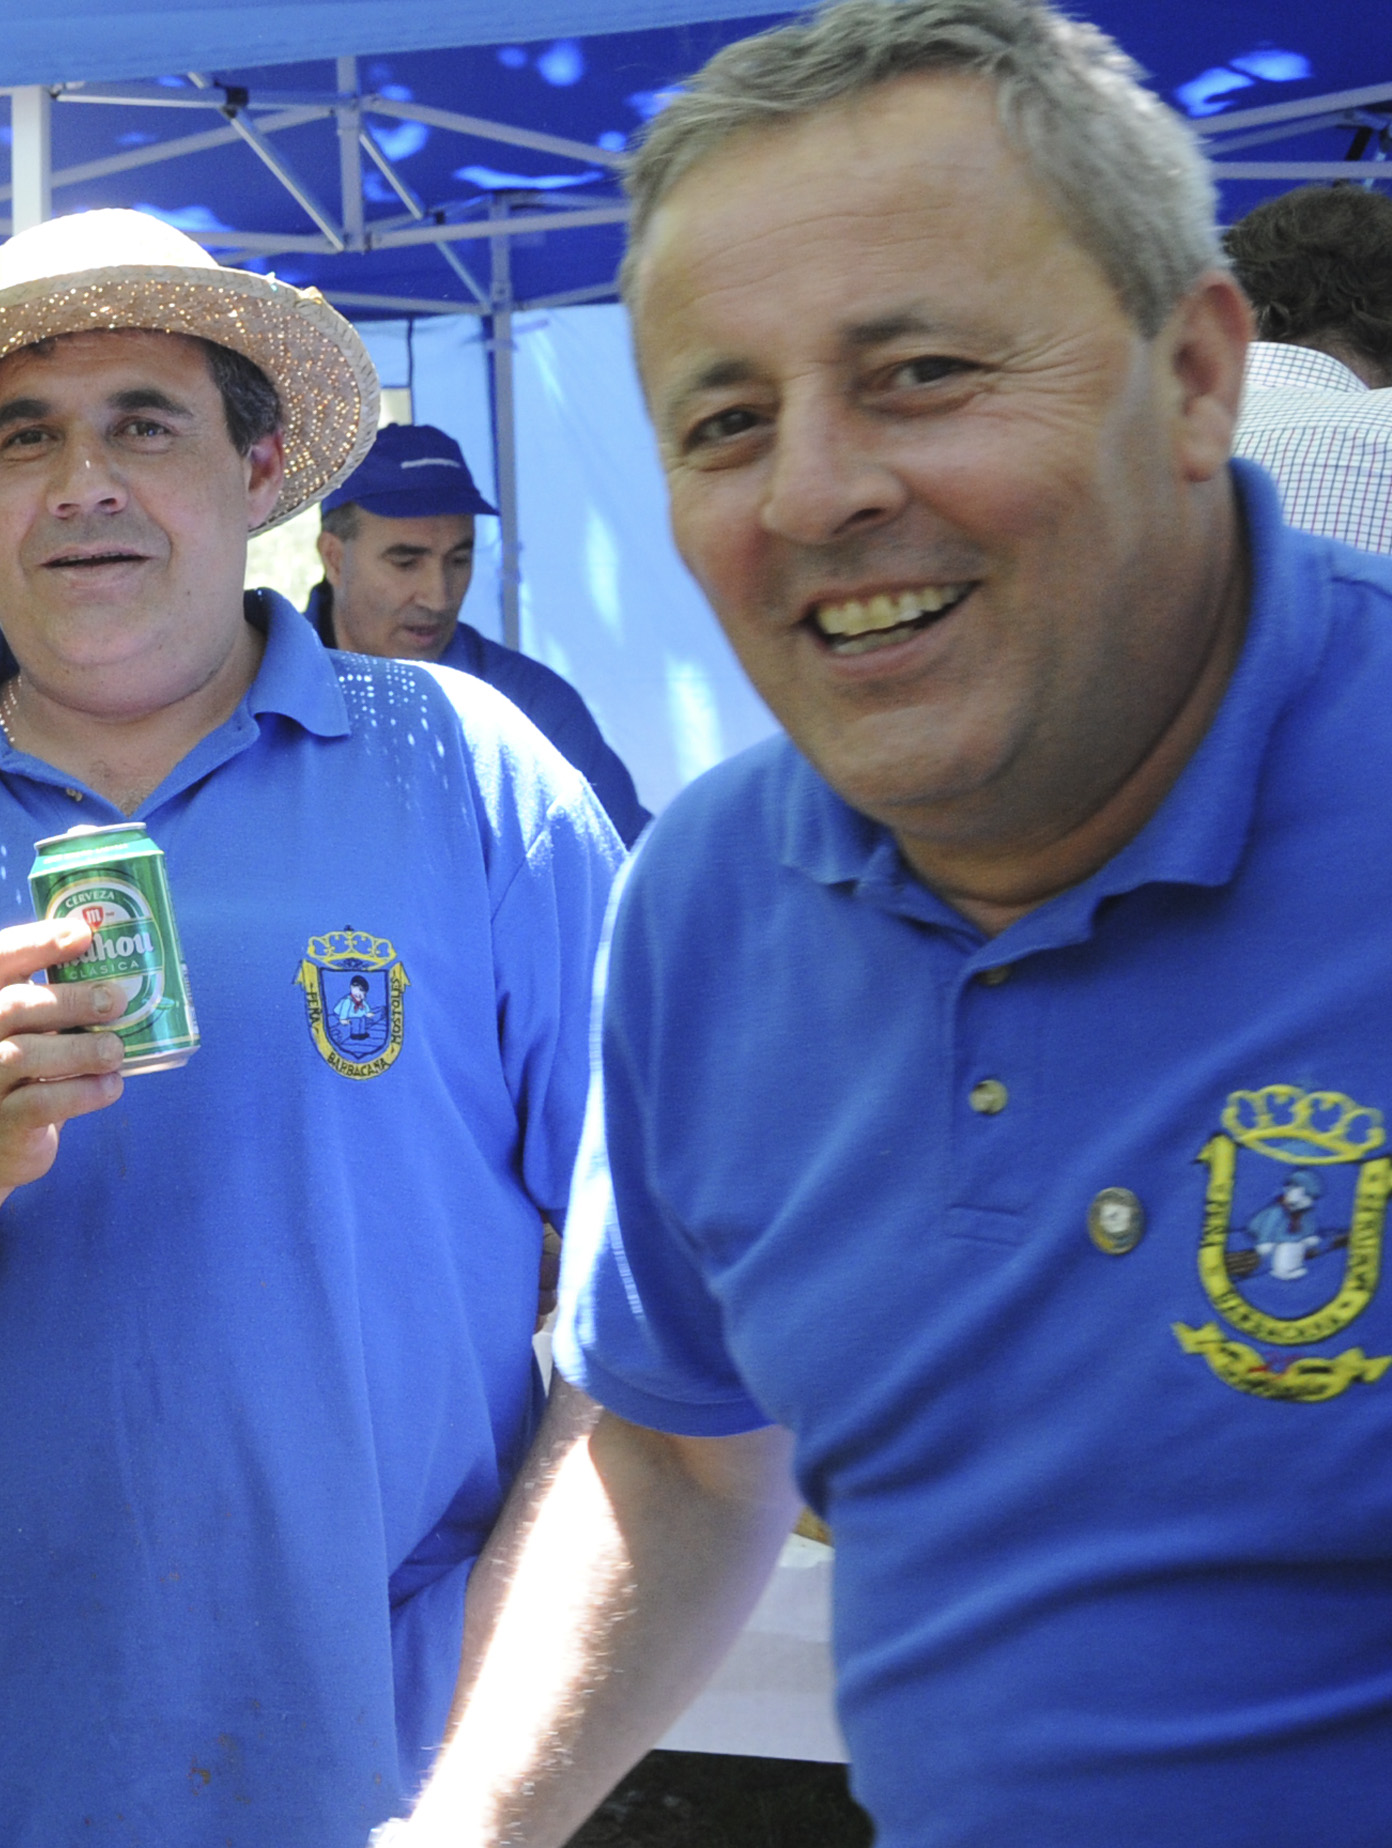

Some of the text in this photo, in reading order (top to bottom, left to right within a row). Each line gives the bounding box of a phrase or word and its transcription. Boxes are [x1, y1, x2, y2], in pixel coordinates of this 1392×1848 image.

[65, 889, 115, 908] CERVEZA
[69, 960, 140, 980] CLASICA
[327, 1051, 391, 1077] BARBACANA
